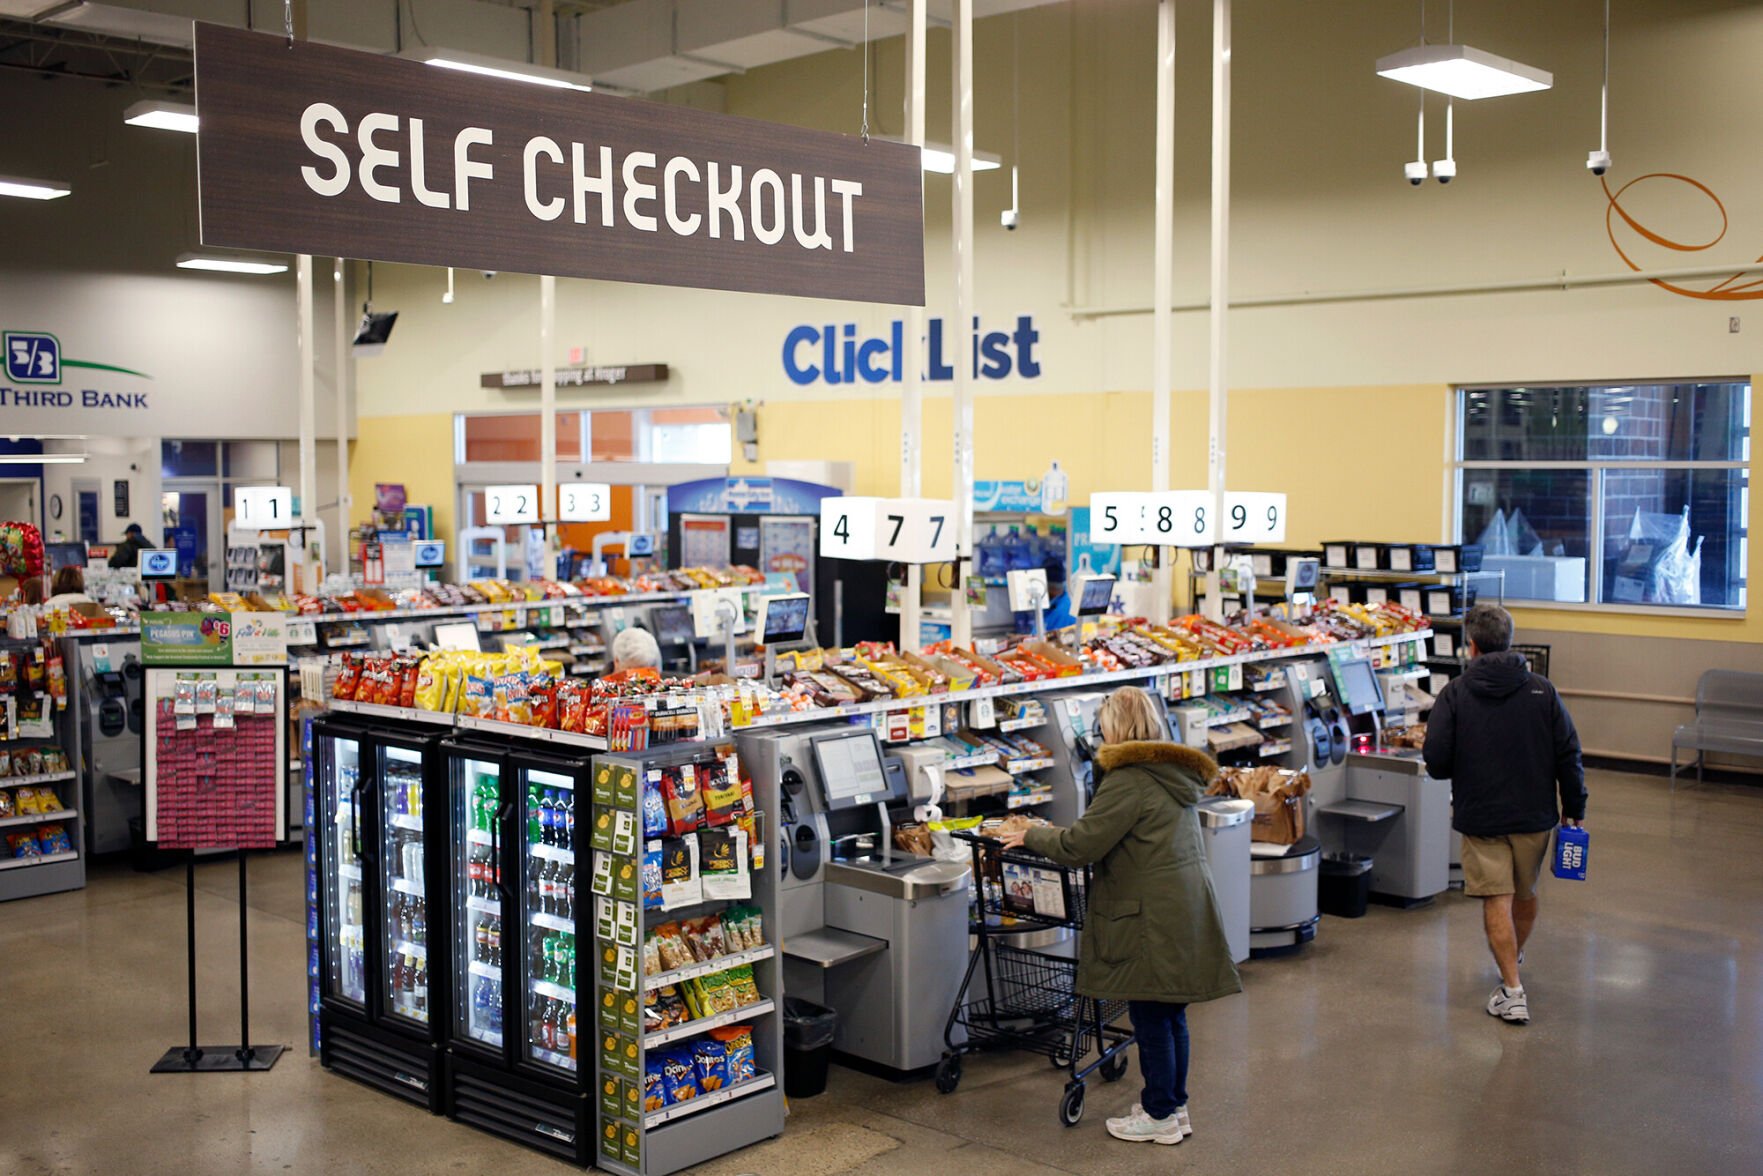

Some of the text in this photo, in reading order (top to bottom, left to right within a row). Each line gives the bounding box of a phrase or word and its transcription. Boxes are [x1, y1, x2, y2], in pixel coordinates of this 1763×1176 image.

[300, 102, 864, 253] SELF CHECKOUT
[81, 390, 149, 409] BANK
[243, 498, 249, 520] 1
[269, 498, 278, 519] 1
[493, 496, 501, 515] 2
[516, 495, 527, 514] 2
[567, 494, 576, 513] 3
[590, 494, 600, 513] 3
[833, 514, 850, 545] 4
[887, 514, 904, 546] 7
[1103, 505, 1118, 532] 5
[1157, 506, 1173, 533] 8
[1194, 506, 1206, 534] 8
[1231, 504, 1246, 530] 9
[1267, 505, 1277, 531] 9
[929, 516, 945, 548] 7
[1562, 841, 1574, 870] LIGHT
[1571, 845, 1583, 869] BUD
